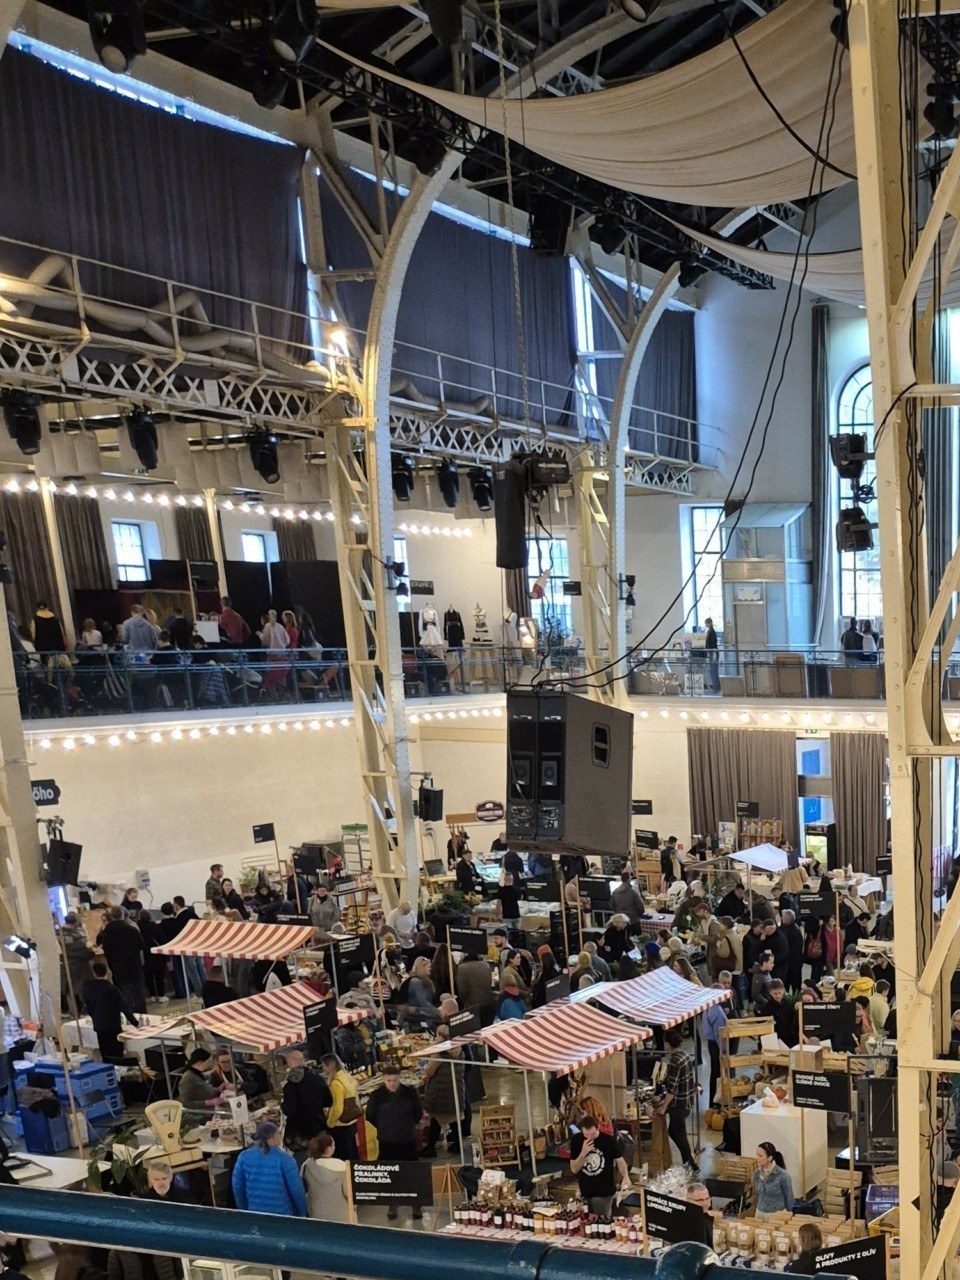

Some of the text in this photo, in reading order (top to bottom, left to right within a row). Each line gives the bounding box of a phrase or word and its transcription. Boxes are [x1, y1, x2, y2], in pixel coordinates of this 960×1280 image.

[815, 1252, 835, 1263] OLIVY
[821, 1253, 856, 1268] PRODUKTY
[861, 1248, 877, 1258] OLÍV
